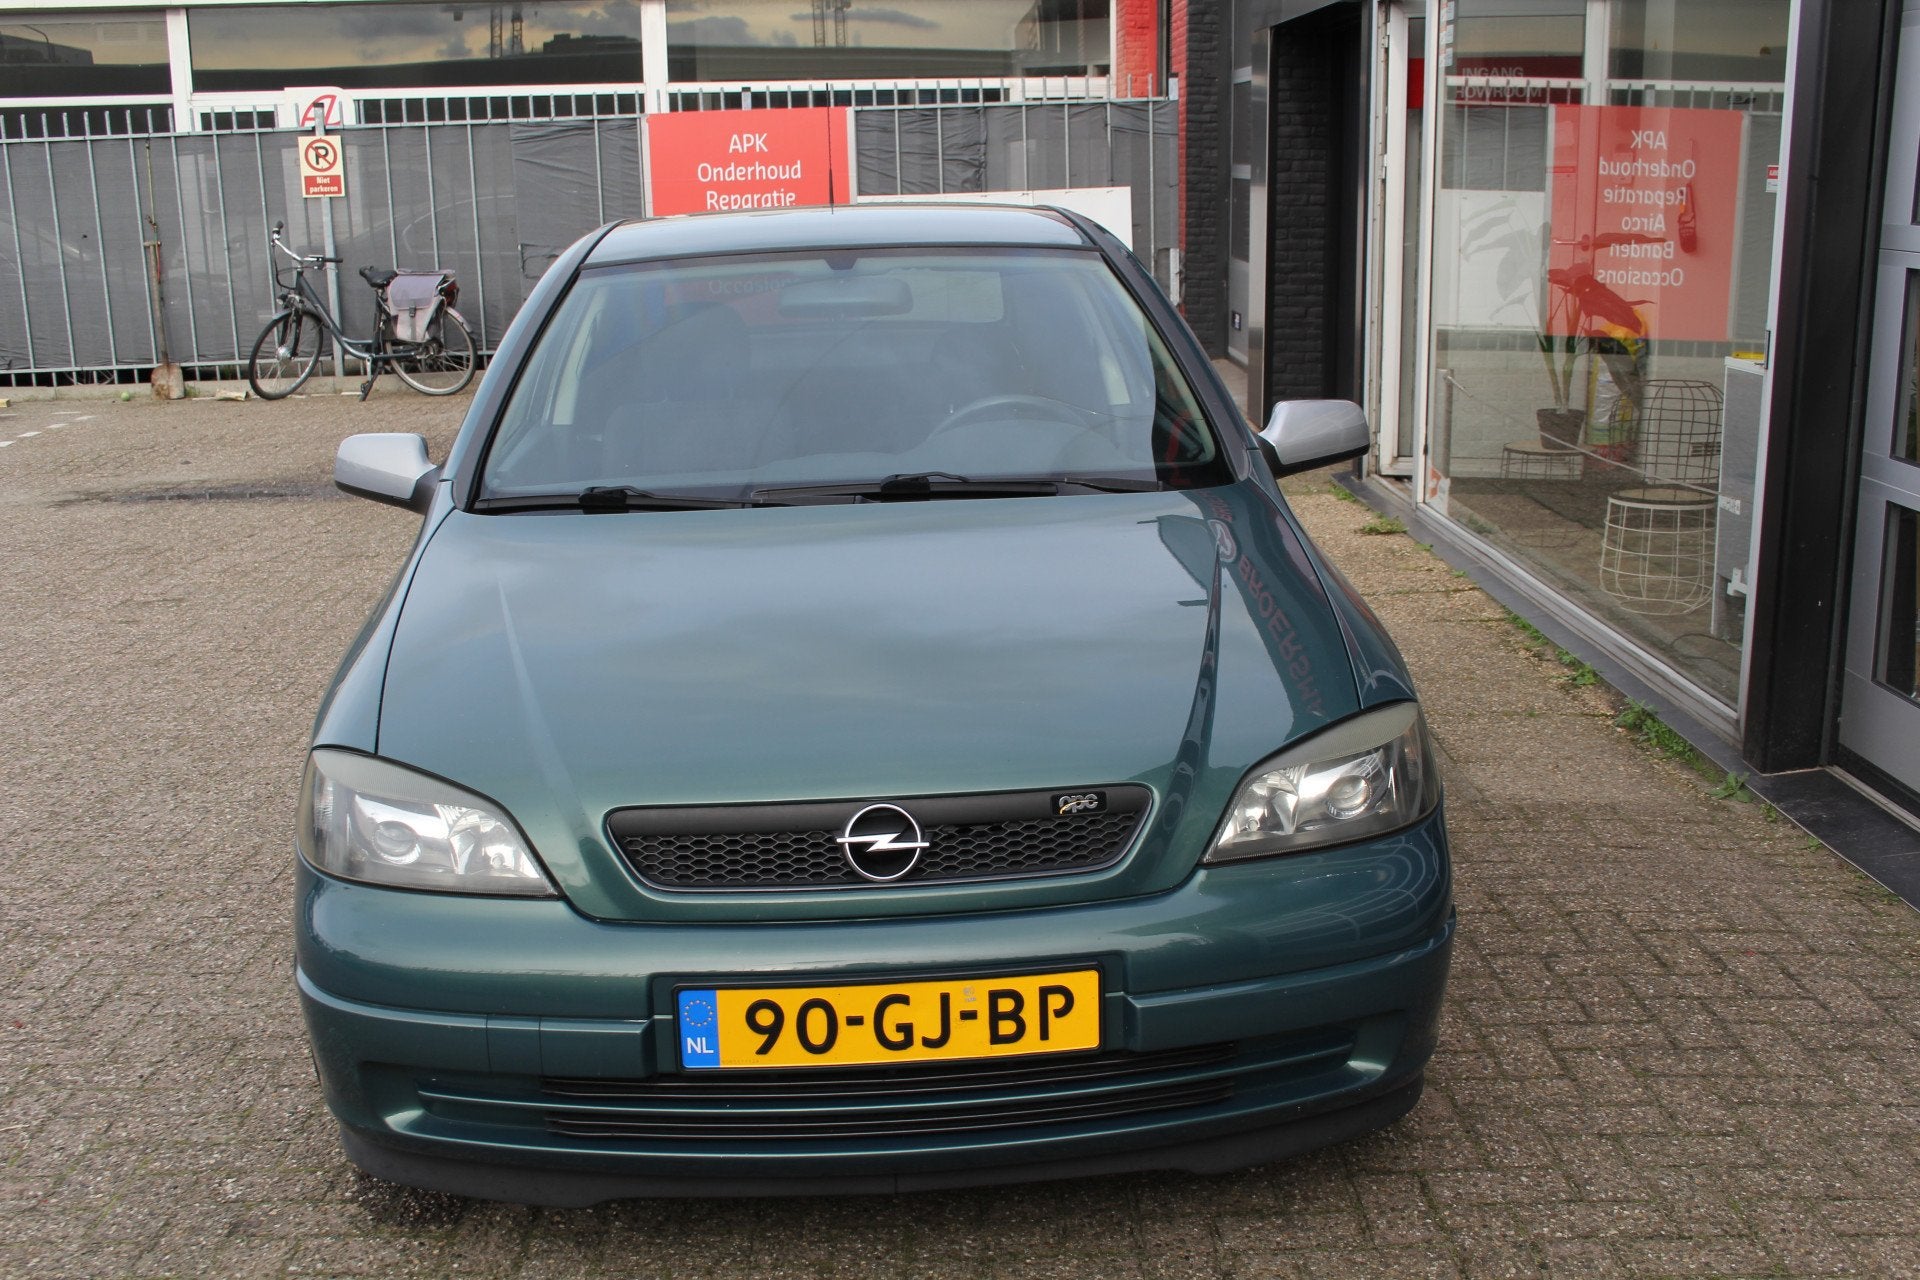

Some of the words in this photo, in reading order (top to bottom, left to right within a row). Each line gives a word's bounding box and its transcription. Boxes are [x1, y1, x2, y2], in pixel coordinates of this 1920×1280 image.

[728, 132, 769, 154] APK
[316, 176, 331, 185] Niet
[697, 159, 802, 183] Onderhoud
[309, 184, 339, 194] parkeren
[705, 187, 797, 210] Reparatie
[745, 984, 1075, 1056] 90-GJ-BP
[686, 1036, 715, 1055] NL
